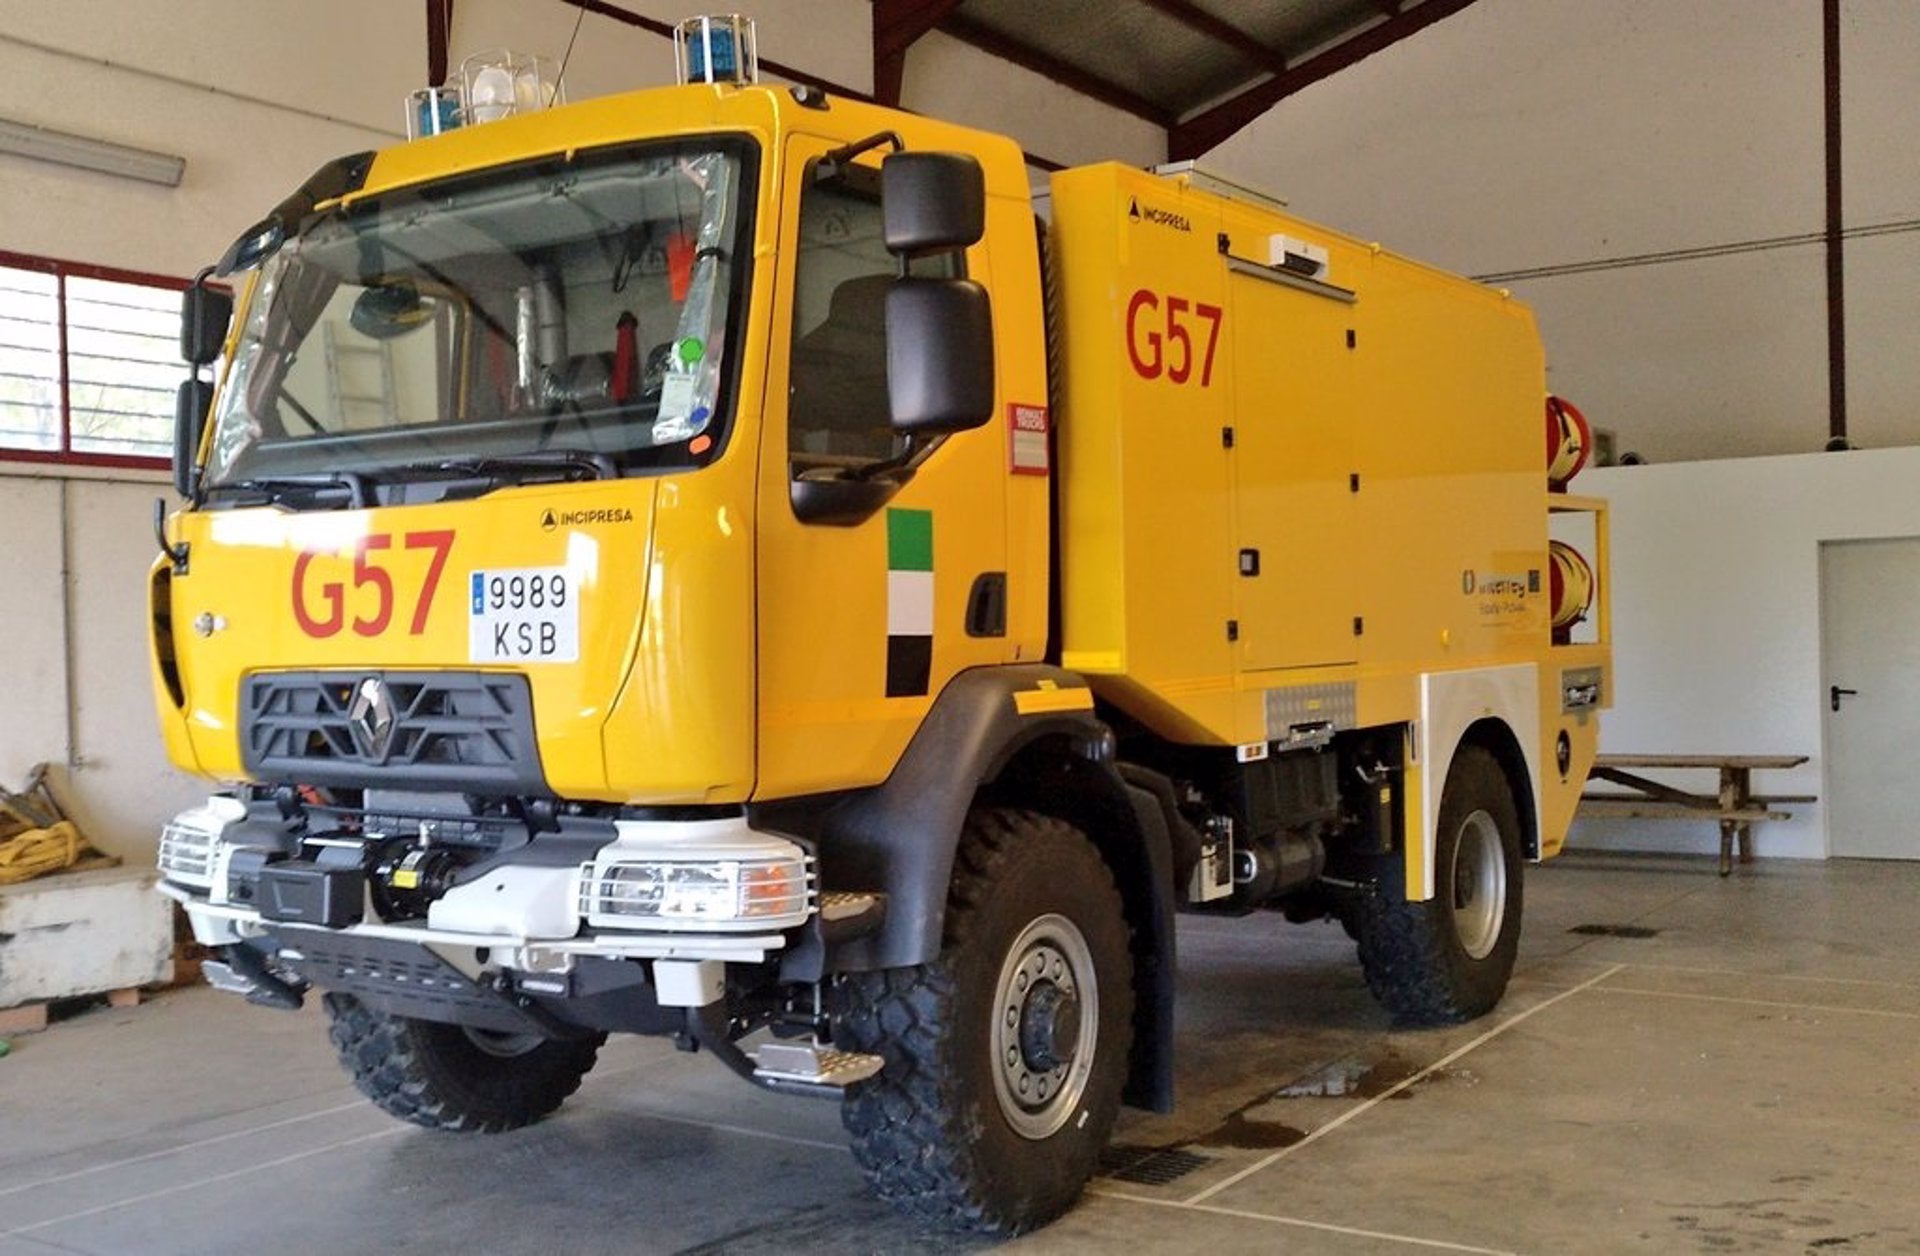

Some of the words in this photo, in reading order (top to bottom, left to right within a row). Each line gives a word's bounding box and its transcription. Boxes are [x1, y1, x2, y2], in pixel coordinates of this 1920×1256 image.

[1143, 207, 1192, 232] INCIPRESA
[1126, 289, 1223, 388] G57
[561, 509, 633, 526] INCIPRESA
[292, 529, 456, 638] G57
[490, 574, 566, 610] 9989
[494, 621, 557, 656] KSB
